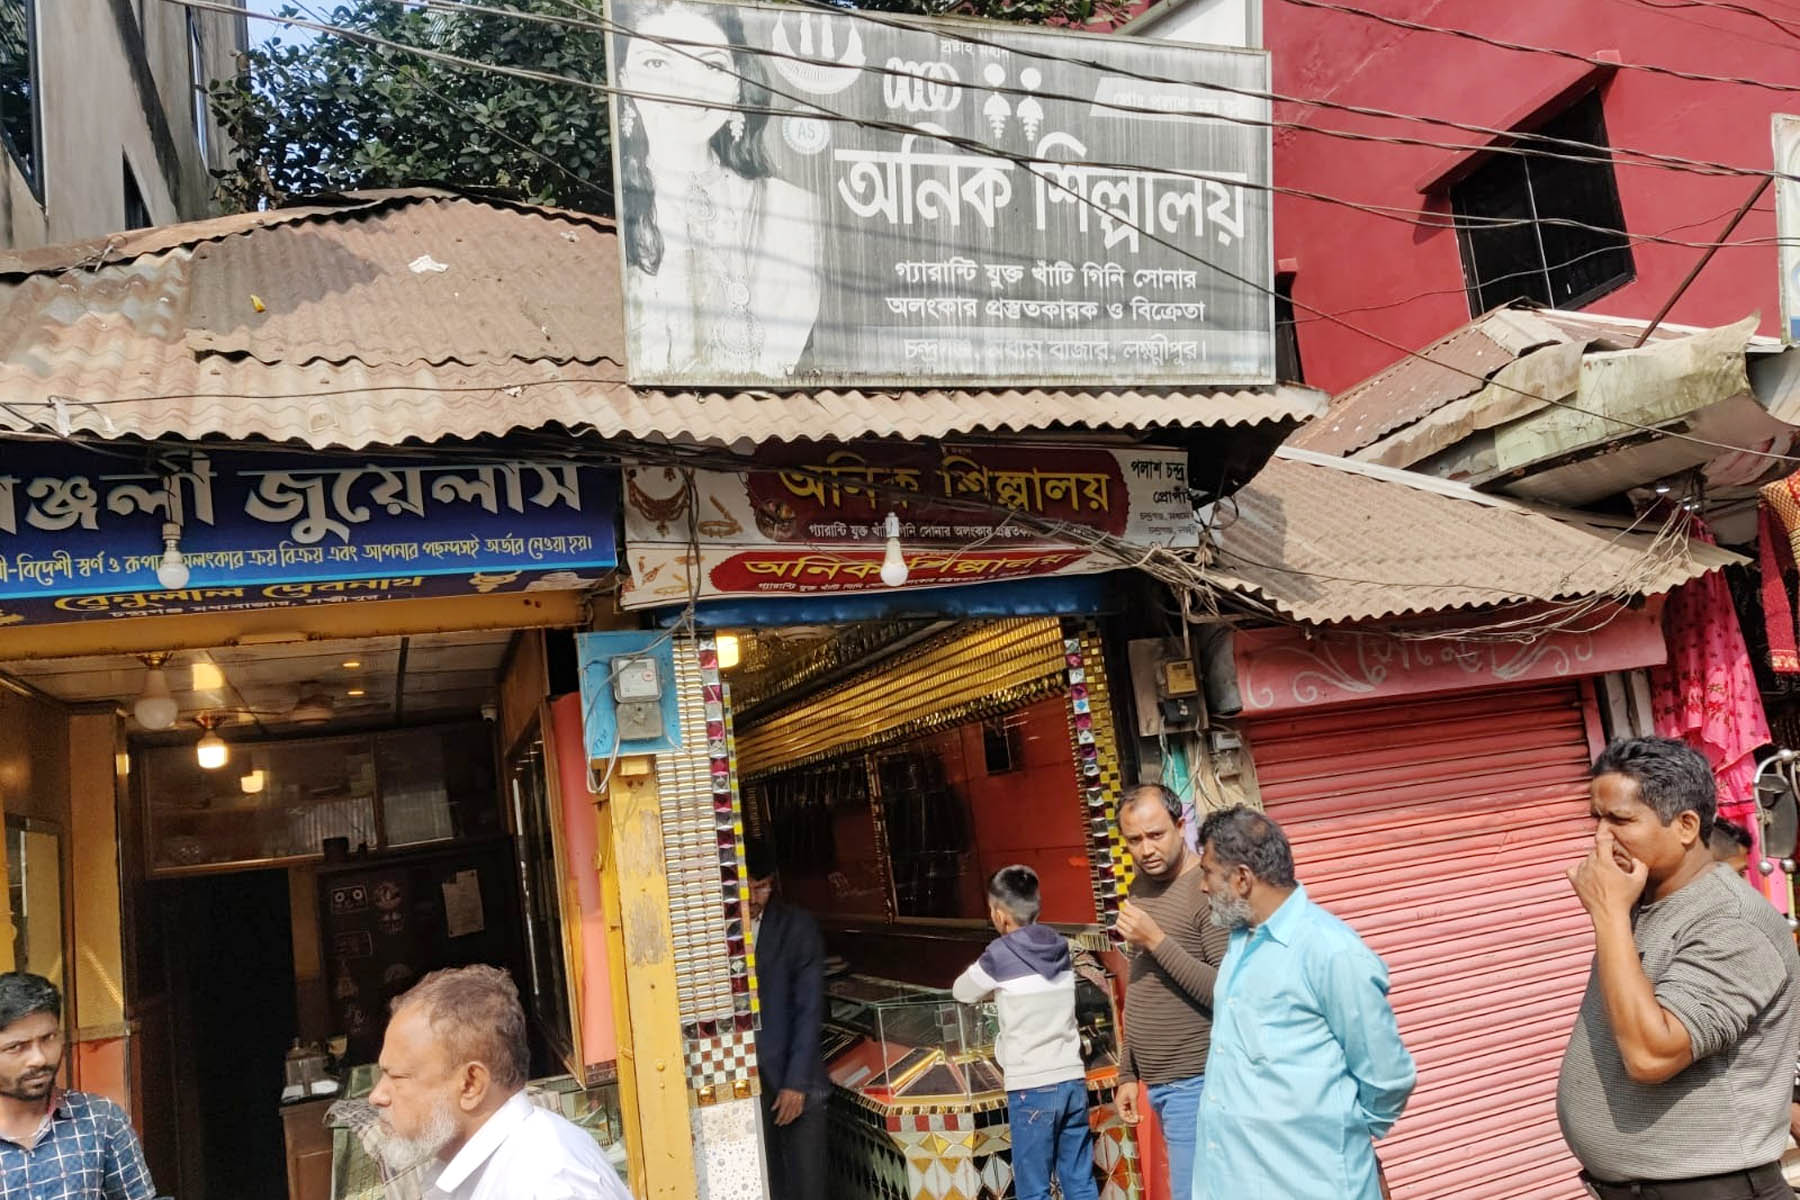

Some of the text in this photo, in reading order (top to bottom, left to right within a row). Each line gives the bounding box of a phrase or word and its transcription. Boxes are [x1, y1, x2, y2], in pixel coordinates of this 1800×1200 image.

[797, 120, 816, 141] AS
[834, 122, 1247, 253] অনিক শিল্পালয়
[895, 256, 1198, 290] গ্যারান্টি যুক্ত খাঁটি গিনি সোনার
[886, 296, 978, 319] অলংকার
[1106, 303, 1124, 320] ও
[1130, 295, 1206, 322] বিক্রেতা
[937, 455, 1110, 512] শিল্পালয়
[74, 550, 105, 576] স্বর্ণ
[108, 557, 120, 573] ও
[246, 549, 277, 567] ক্রয়
[279, 540, 323, 567] বিক্রয়
[327, 545, 359, 562] এবং
[361, 542, 419, 563] আপনার
[484, 532, 524, 556] অর্ডার
[743, 555, 882, 580] অনিক
